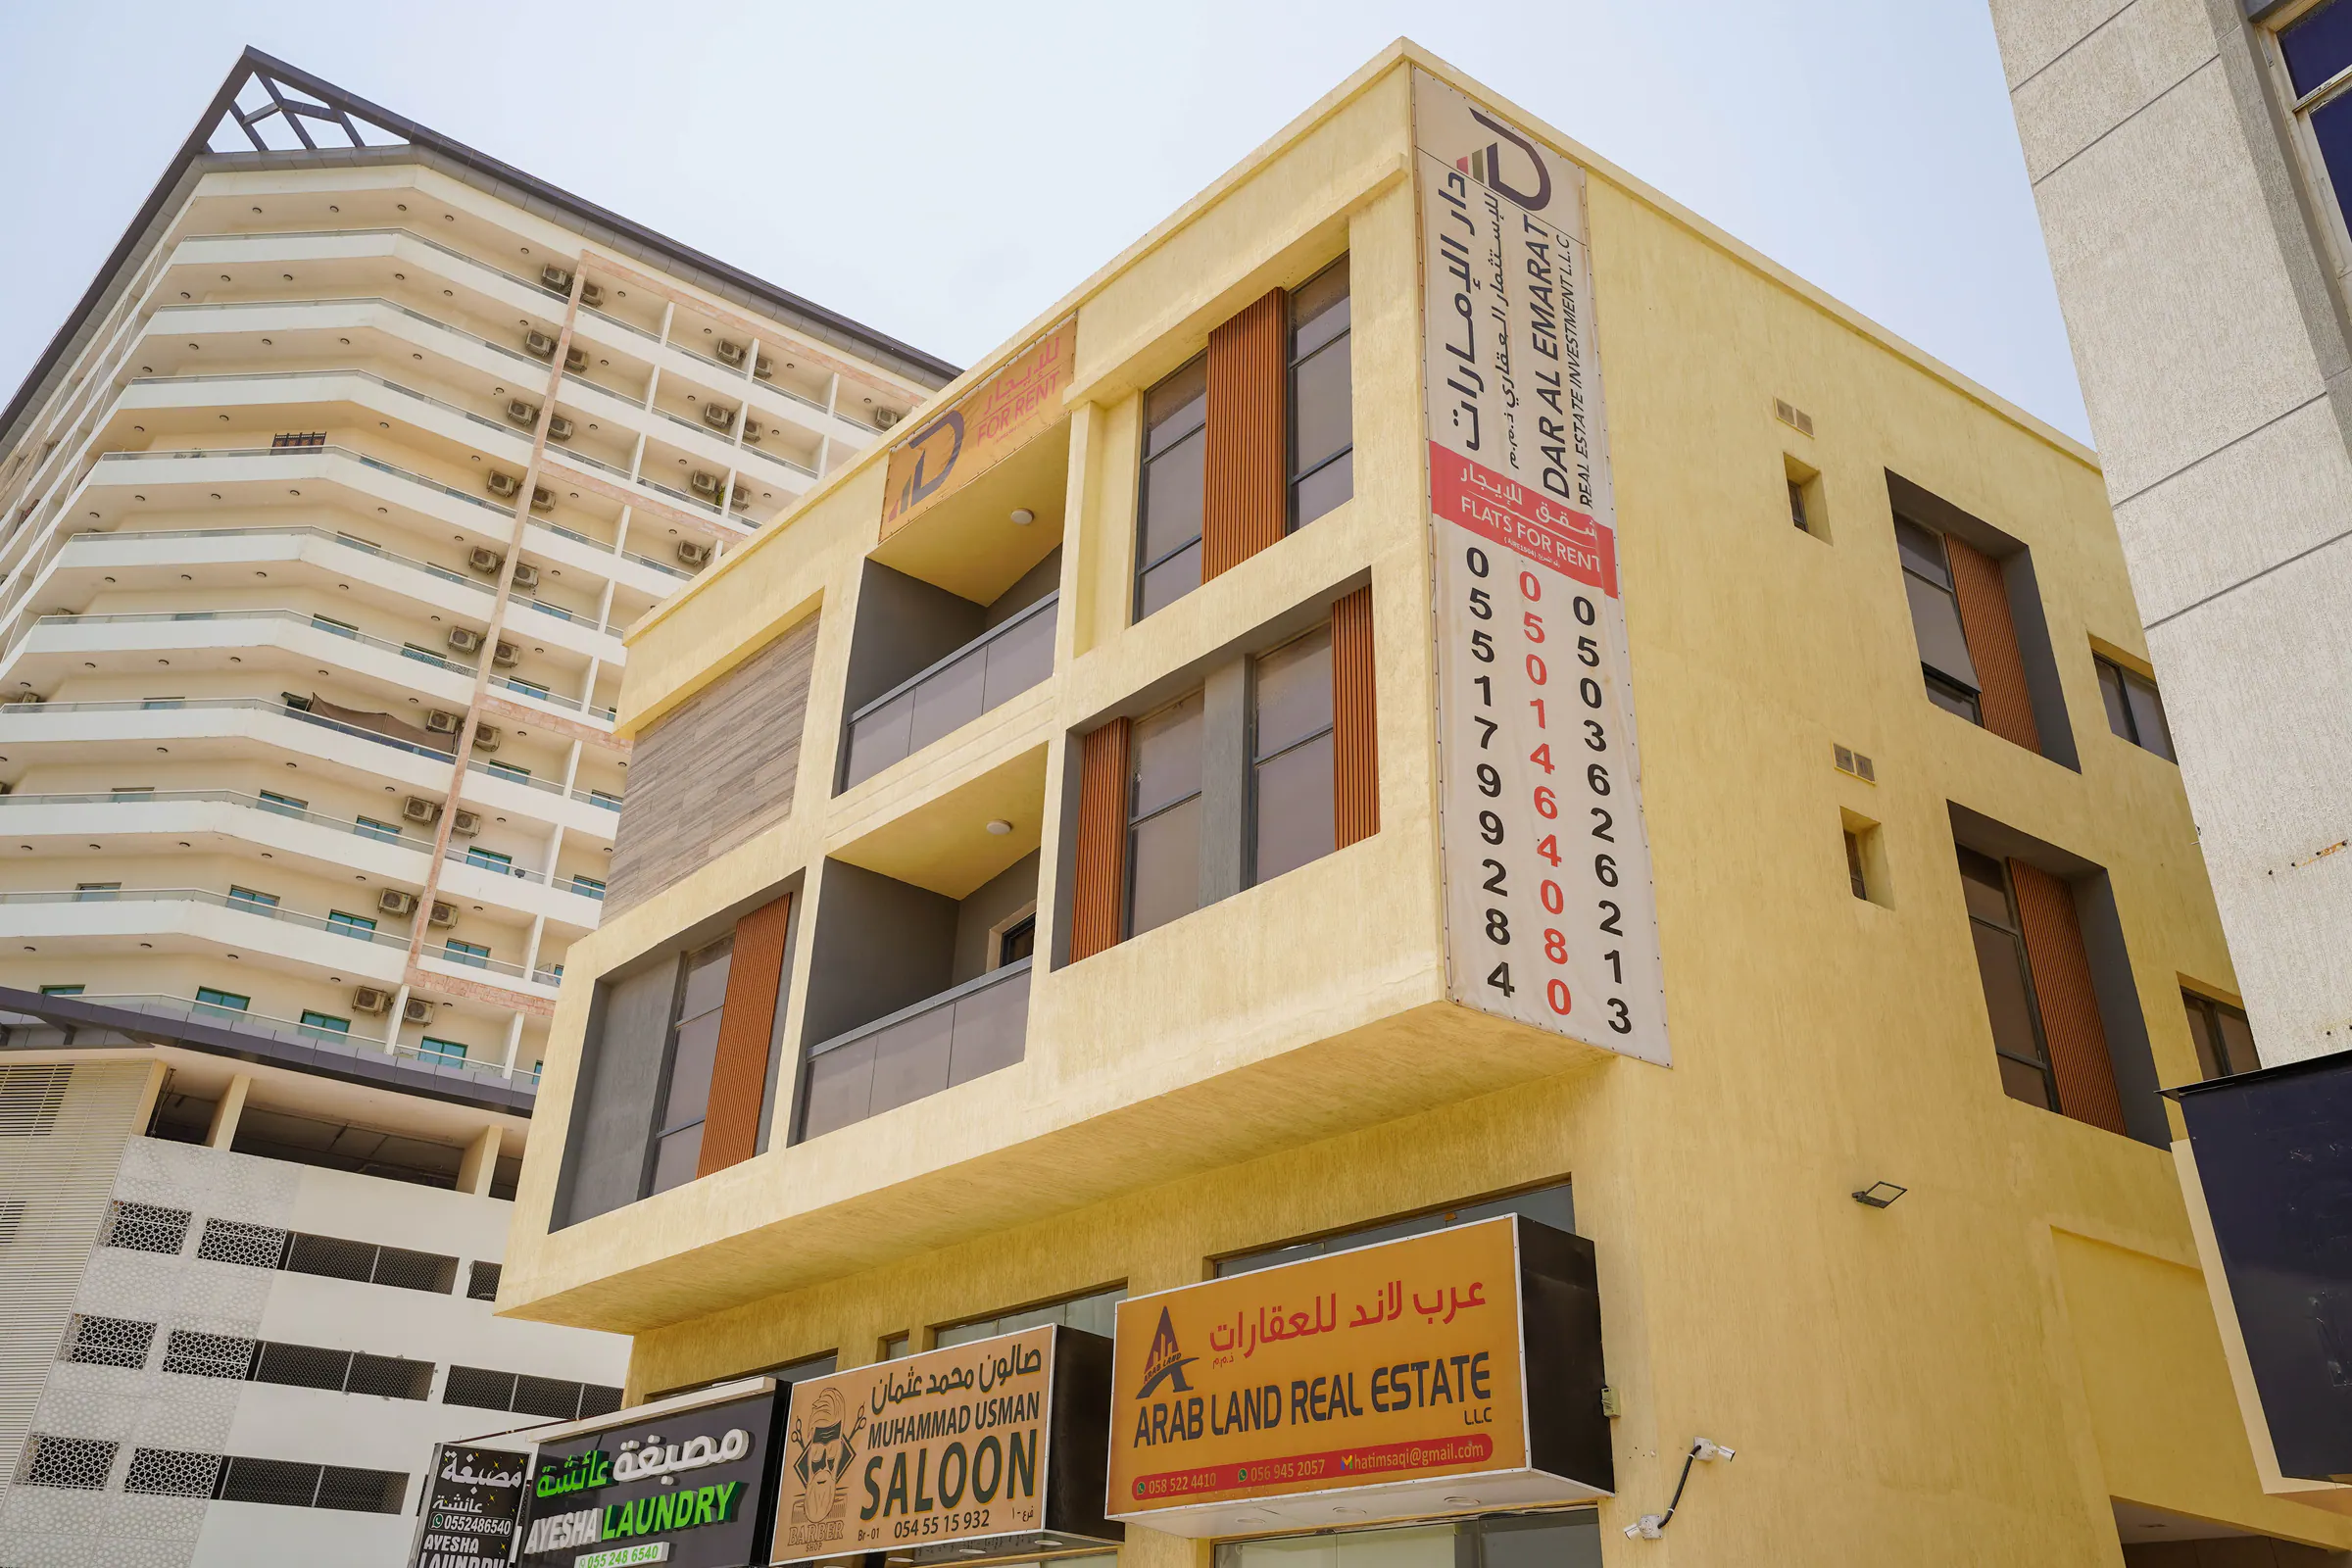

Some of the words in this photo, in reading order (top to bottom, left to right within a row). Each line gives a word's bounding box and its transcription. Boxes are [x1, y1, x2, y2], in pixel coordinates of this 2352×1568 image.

[1438, 172, 1475, 236] دار
[1556, 234, 1573, 277] L.L.C
[1523, 214, 1559, 362] EMARAT
[1440, 233, 1485, 452] الإمارات
[1560, 274, 1583, 389] INVESTMENT
[1491, 306, 1519, 409] العقاري
[977, 407, 1010, 447] FOR
[1014, 371, 1059, 420] RENT
[1535, 370, 1564, 416] AL
[1570, 389, 1589, 459] ESTATE
[1539, 416, 1570, 500] DAR
[1460, 464, 1523, 506] للإيجار
[1577, 464, 1592, 510] REAL
[1460, 495, 1513, 533] FLATS
[1517, 521, 1551, 554] FOR
[1556, 541, 1600, 572] RENT
[1536, 501, 1598, 541] شقق
[1209, 1293, 1337, 1358] للعقارات
[1348, 1280, 1403, 1328] لاند
[1412, 1281, 1486, 1324] عرب
[871, 1365, 923, 1416] عثمان
[925, 1367, 974, 1396] محمد
[978, 1344, 1042, 1394] صالون
[1144, 1364, 1161, 1384] ARAB
[1163, 1352, 1182, 1367] LAND
[867, 1404, 971, 1450] MUHAMMAD
[975, 1391, 1040, 1430] USMAN
[1133, 1396, 1204, 1448] ARAB
[1210, 1385, 1282, 1437] LAND
[1291, 1372, 1363, 1425] REAL
[1371, 1351, 1492, 1412] ESTATE
[440, 1450, 522, 1494] مصبغة
[536, 1449, 612, 1498] عائشة
[612, 1429, 750, 1486] مصبغة
[859, 1429, 1038, 1521] SALOON
[1250, 1465, 1271, 1482] 056
[1274, 1462, 1294, 1479] 945
[1298, 1458, 1325, 1477] 2057
[1354, 1443, 1484, 1470] hatimsaqi@gmail.com
[432, 1494, 483, 1513] عائشة
[1149, 1480, 1167, 1494] 058
[1169, 1477, 1188, 1492] 522
[1191, 1473, 1216, 1489] 4410
[444, 1515, 512, 1536] 0552486540
[523, 1507, 604, 1555] AYESHA
[602, 1481, 741, 1541] LAUNDRY
[787, 1519, 845, 1546] BARBER
[894, 1519, 919, 1539] 054
[921, 1516, 939, 1536] 55
[944, 1513, 959, 1533] 15
[963, 1509, 990, 1530] 932
[423, 1534, 480, 1554] AYESHA
[587, 1553, 607, 1568] 055
[608, 1548, 628, 1566] 248
[631, 1544, 659, 1563] 6540
[806, 1542, 823, 1552] SHOP
